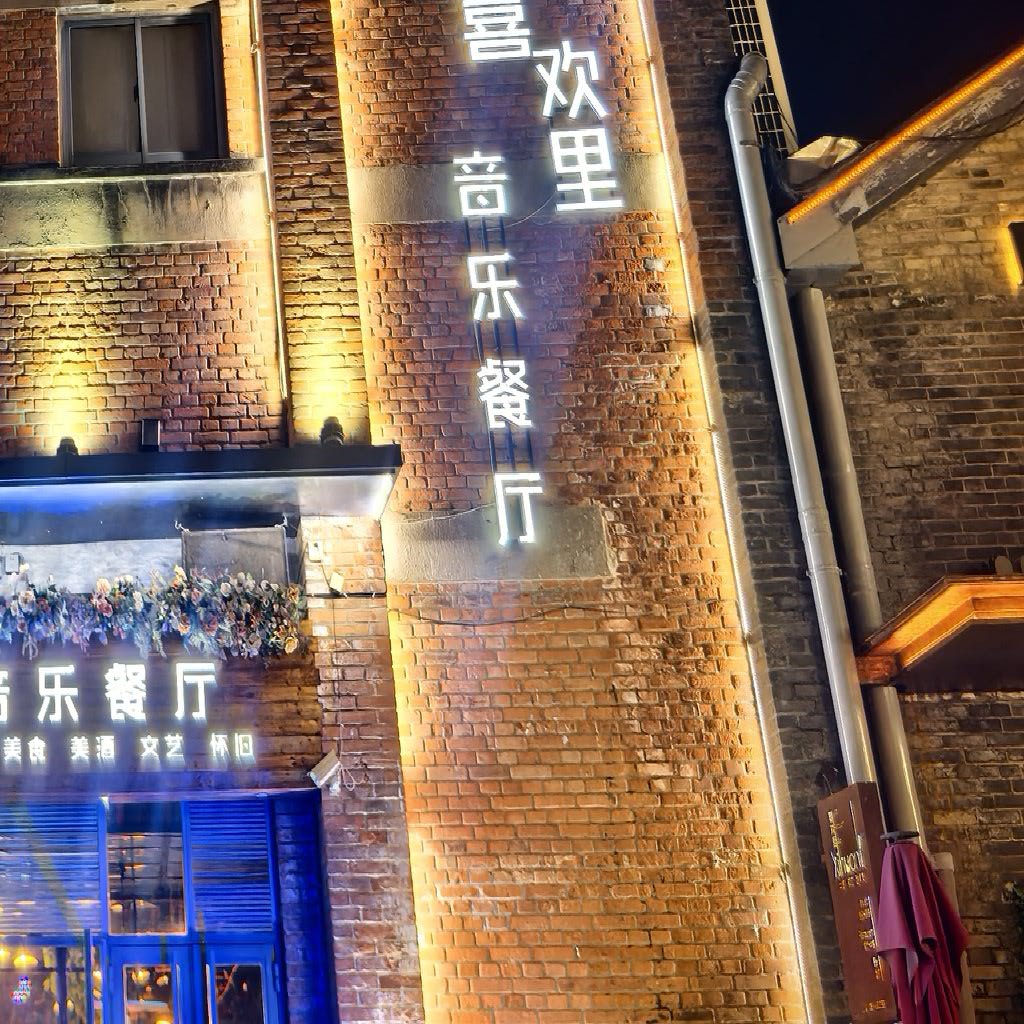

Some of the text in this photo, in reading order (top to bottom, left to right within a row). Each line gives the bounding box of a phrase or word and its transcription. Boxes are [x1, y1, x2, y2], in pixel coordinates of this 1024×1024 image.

[452, 150, 544, 547] 音乐餐厅
[3, 733, 252, 761] 美食 美酒 文艺 怀旧
